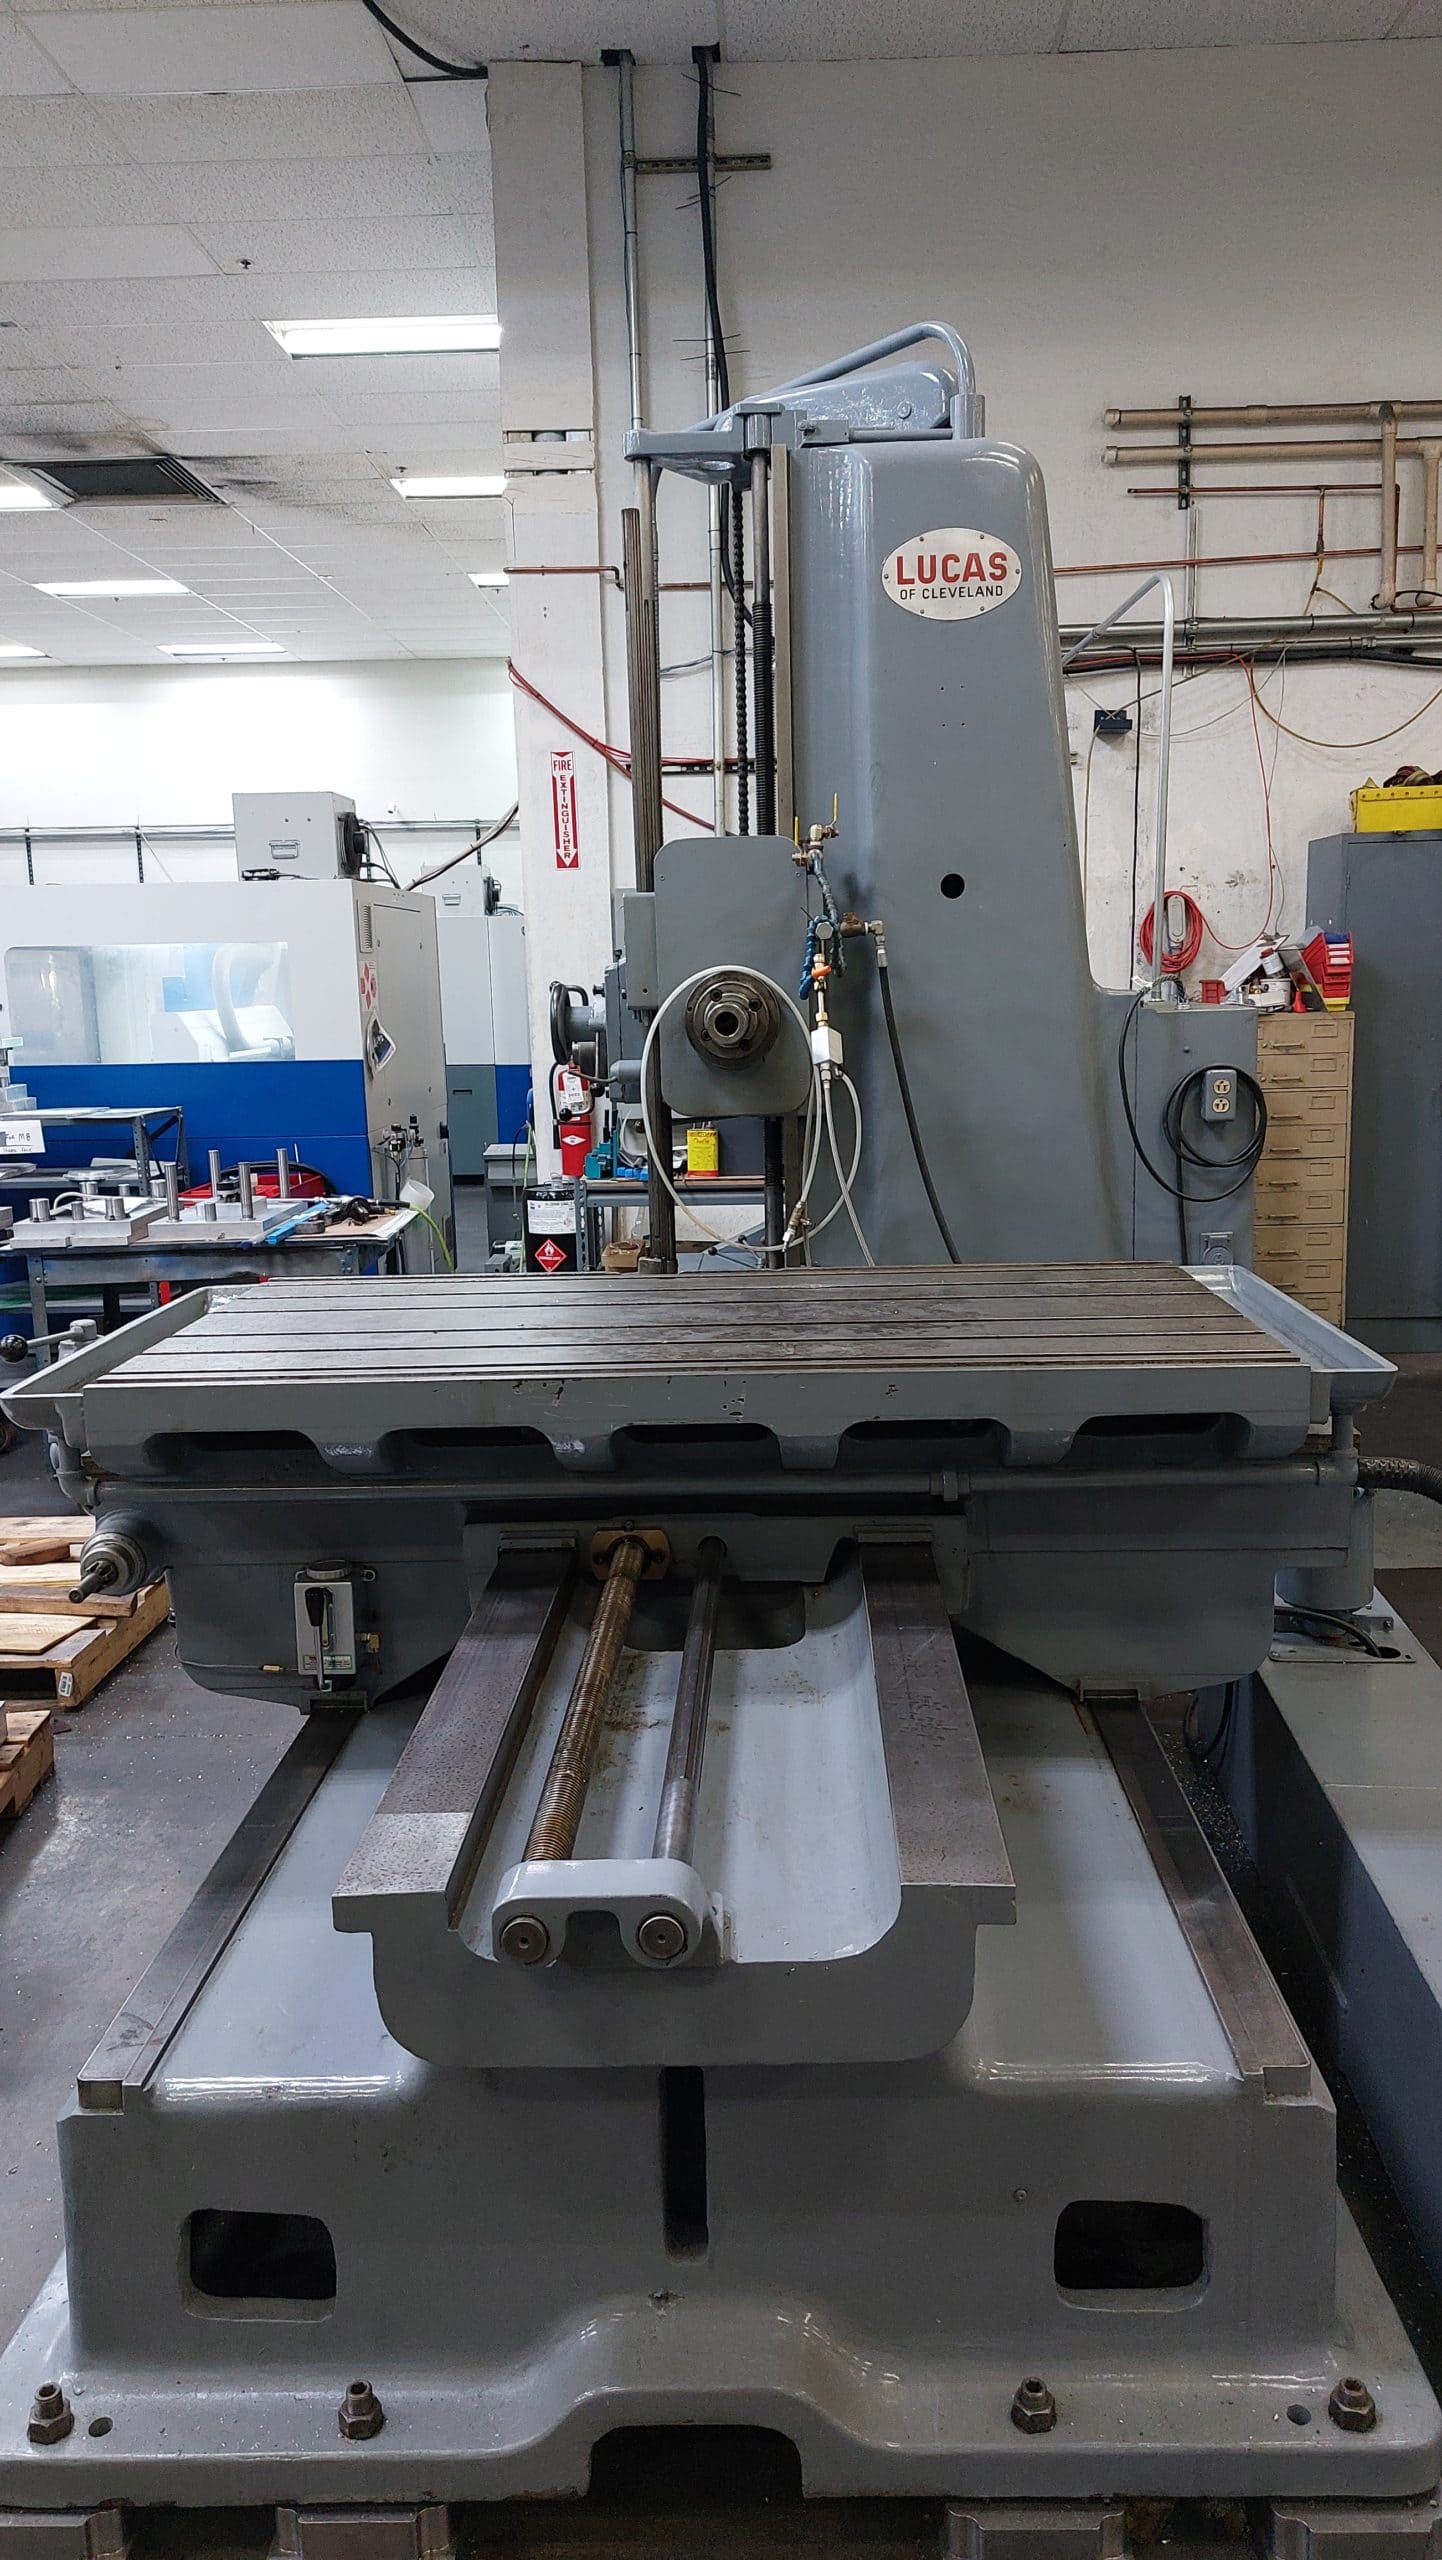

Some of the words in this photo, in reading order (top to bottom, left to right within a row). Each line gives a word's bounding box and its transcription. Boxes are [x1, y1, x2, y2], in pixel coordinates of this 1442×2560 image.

[897, 552, 1007, 585] LUCAS
[900, 589, 916, 600] OF
[922, 585, 1003, 599] CLEVELAND
[553, 760, 572, 771] FIRE
[560, 775, 571, 859] EXTINGUISHER
